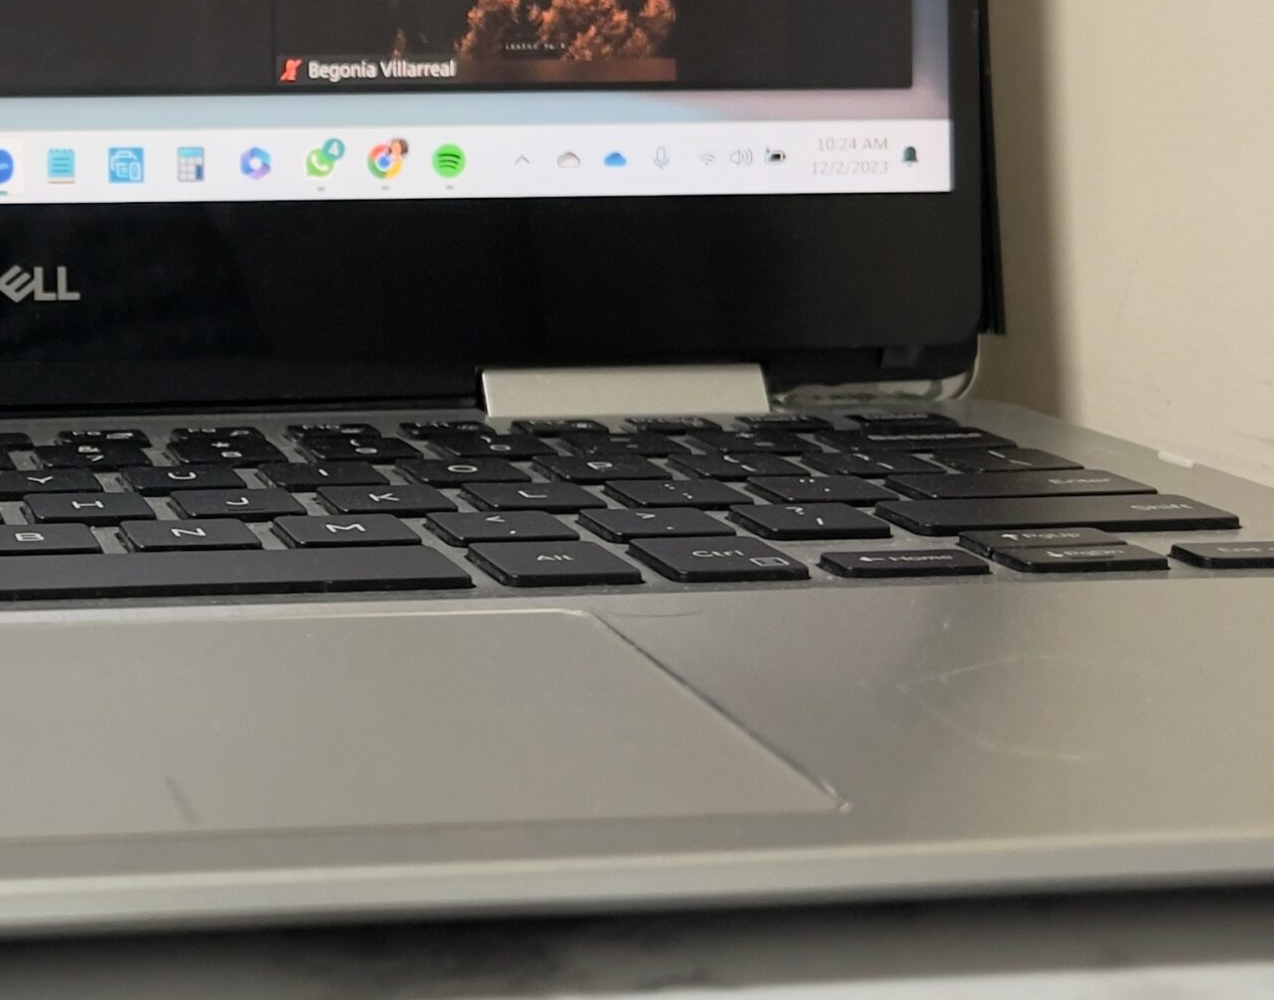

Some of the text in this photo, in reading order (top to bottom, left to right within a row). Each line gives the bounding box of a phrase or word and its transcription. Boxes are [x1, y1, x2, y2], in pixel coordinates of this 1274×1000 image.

[308, 58, 457, 83] Begonia Villarreal
[862, 137, 889, 151] AM
[536, 554, 575, 563] Alt
[691, 548, 746, 559] Ctrl
